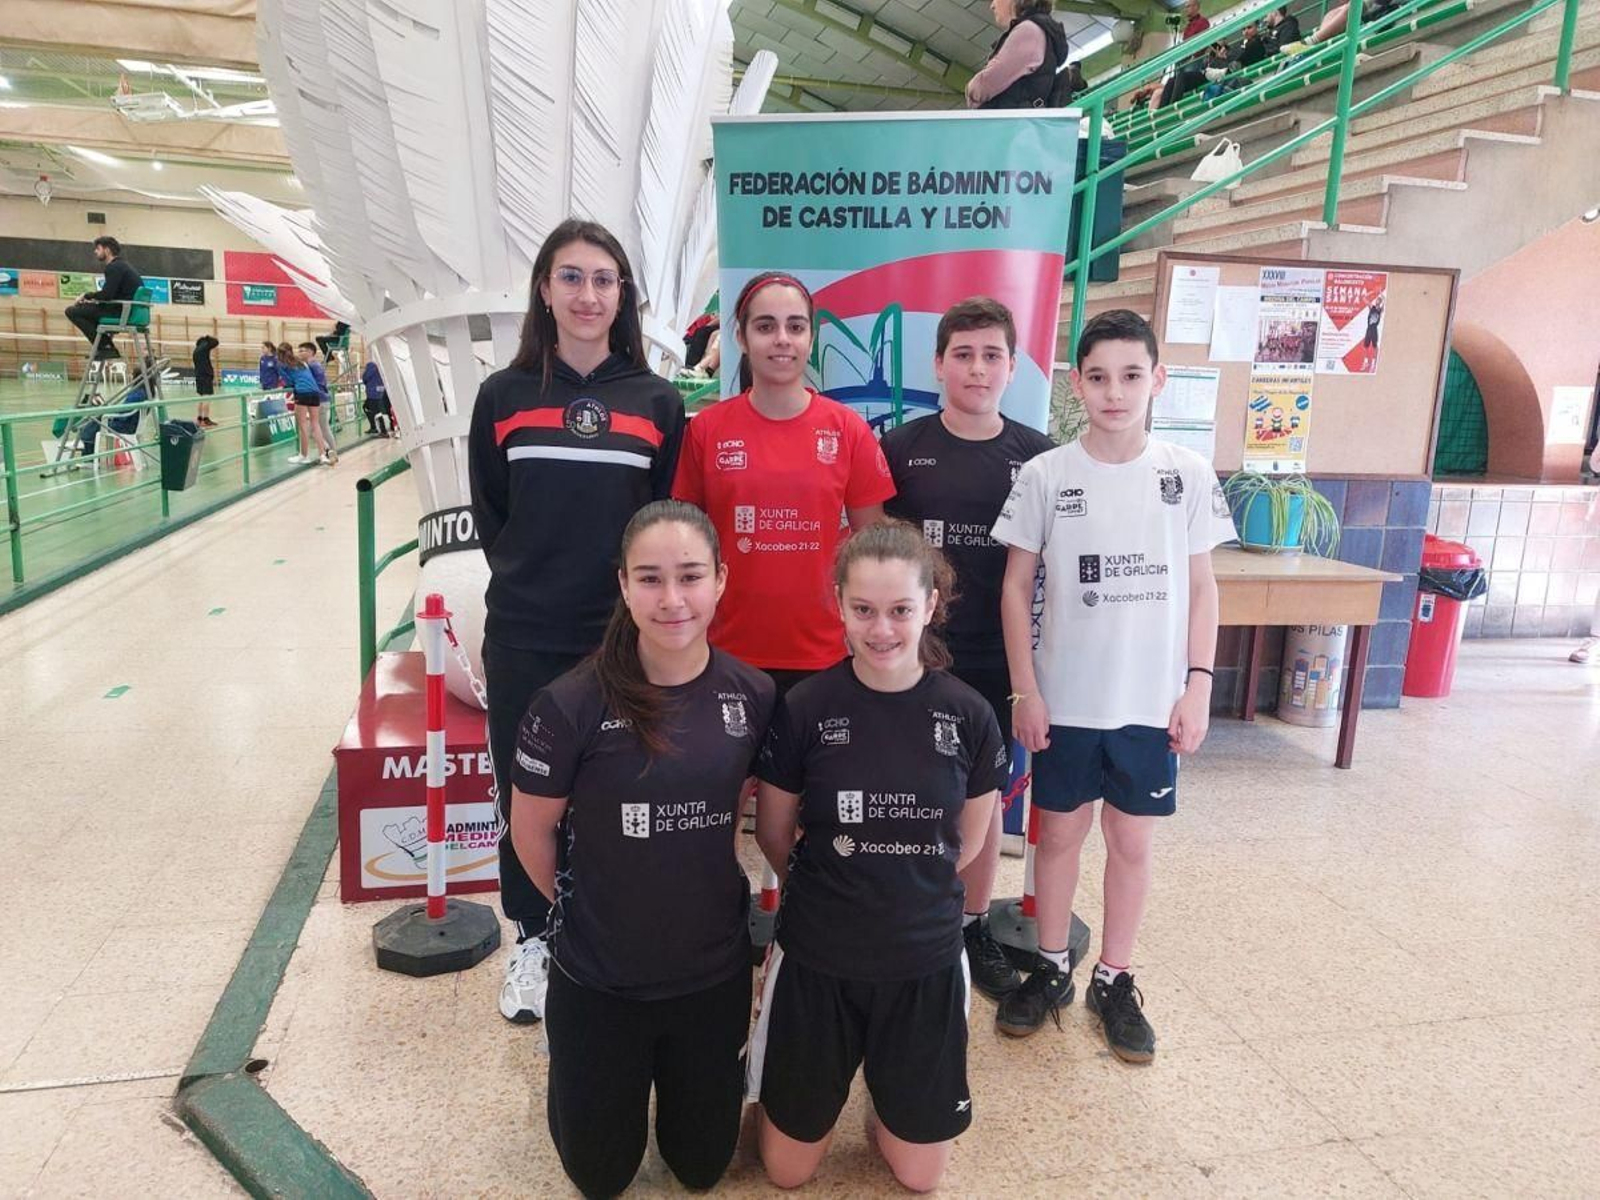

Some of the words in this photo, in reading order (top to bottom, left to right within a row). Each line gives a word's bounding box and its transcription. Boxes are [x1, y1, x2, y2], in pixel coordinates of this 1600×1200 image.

[729, 167, 866, 195] FEDERACIÓN
[871, 172, 899, 195] DE
[907, 166, 1053, 195] BÁDMINTON
[762, 206, 792, 228] DE
[798, 206, 912, 229] CASTILLA
[921, 207, 938, 228] Y
[944, 201, 1012, 229] LEÓN
[759, 508, 798, 519] XUNTA
[759, 520, 772, 530] DE
[775, 520, 821, 531] GALICIA
[949, 523, 987, 534] XUNTA
[755, 541, 798, 551] Xacobeo
[947, 535, 962, 545] DE
[1104, 554, 1145, 566] XUNTA
[1104, 567, 1120, 578] DE
[1123, 564, 1168, 576] GALICIA
[1102, 593, 1144, 603] Xacobeo
[1308, 625, 1344, 637] PILAS
[868, 793, 916, 805] XUNTA
[656, 800, 707, 817] XUNTA
[868, 807, 887, 818] DE
[888, 807, 944, 820] GALICIA
[655, 819, 673, 832] DE
[677, 812, 732, 830] GALICIA
[859, 841, 921, 855] Xacobeo
